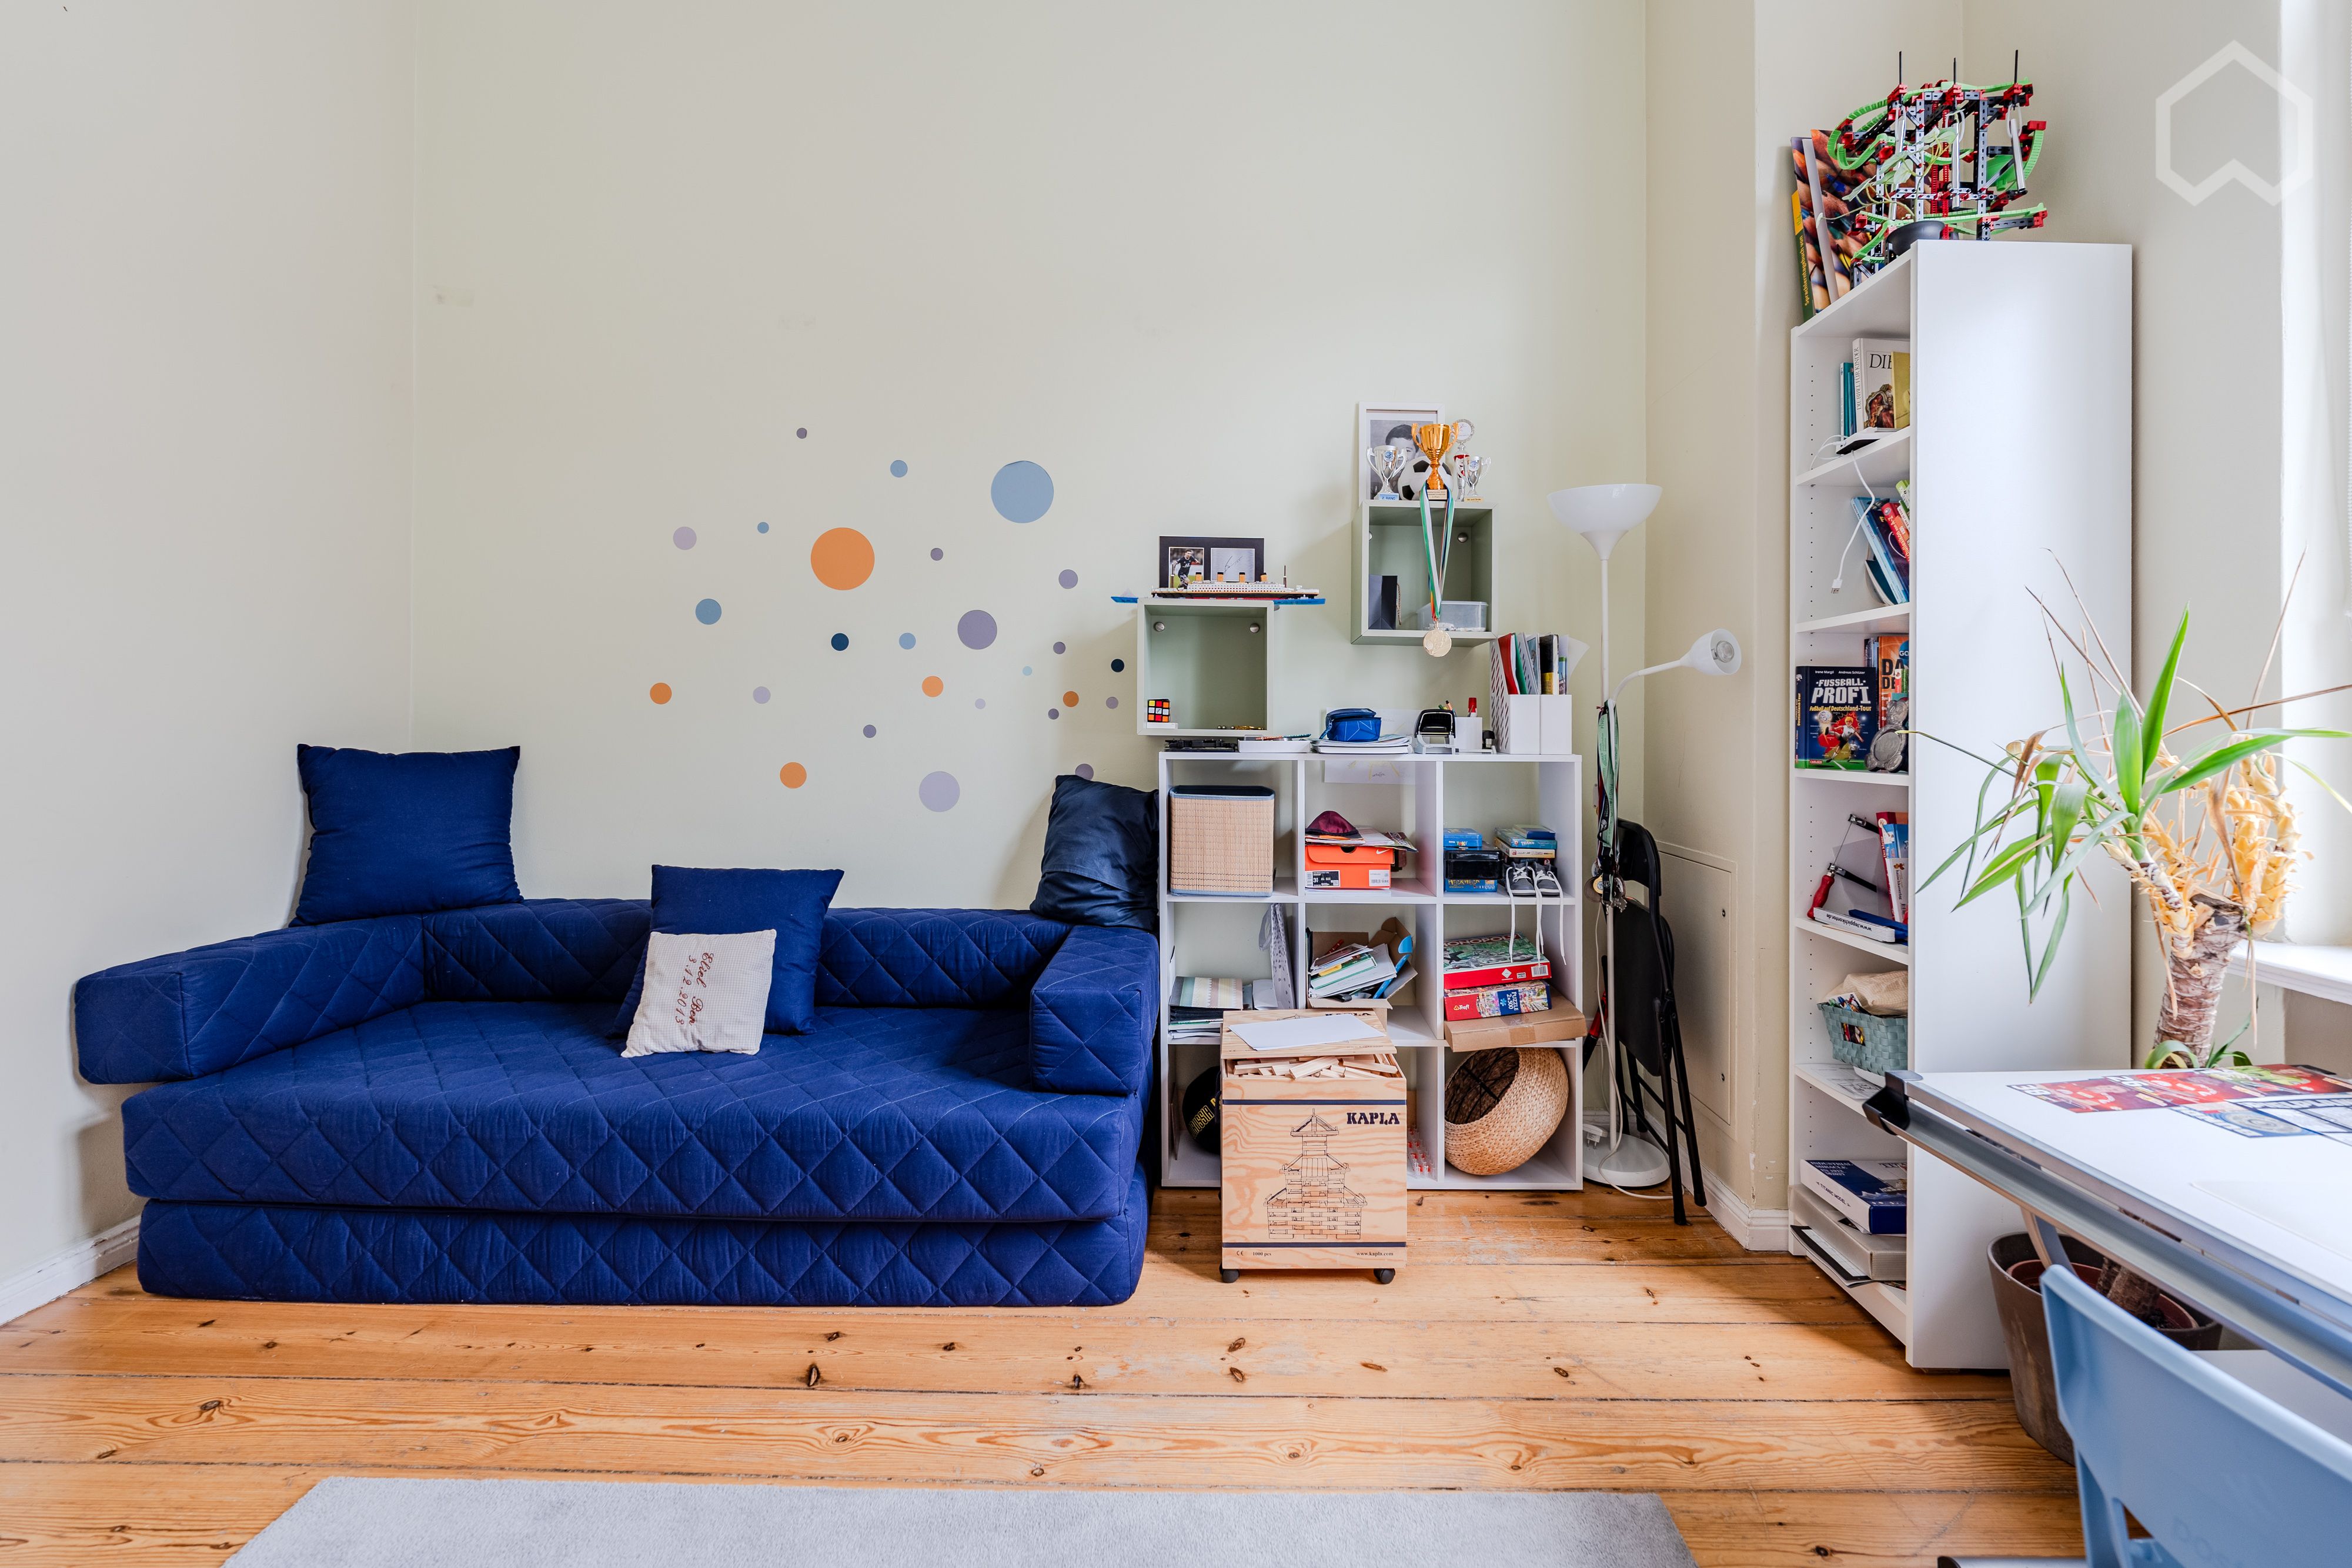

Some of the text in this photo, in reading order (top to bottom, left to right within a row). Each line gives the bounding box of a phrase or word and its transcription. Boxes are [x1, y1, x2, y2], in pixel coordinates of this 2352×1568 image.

[1818, 678, 1864, 687] FUSSBALL
[1811, 687, 1871, 704] PROFI
[1826, 913, 1872, 932] www.teppichkontor.de
[689, 996, 704, 1026] Ben
[1347, 1112, 1400, 1125] KAPLA
[1820, 1184, 1846, 1205] TITANIC MODEL
